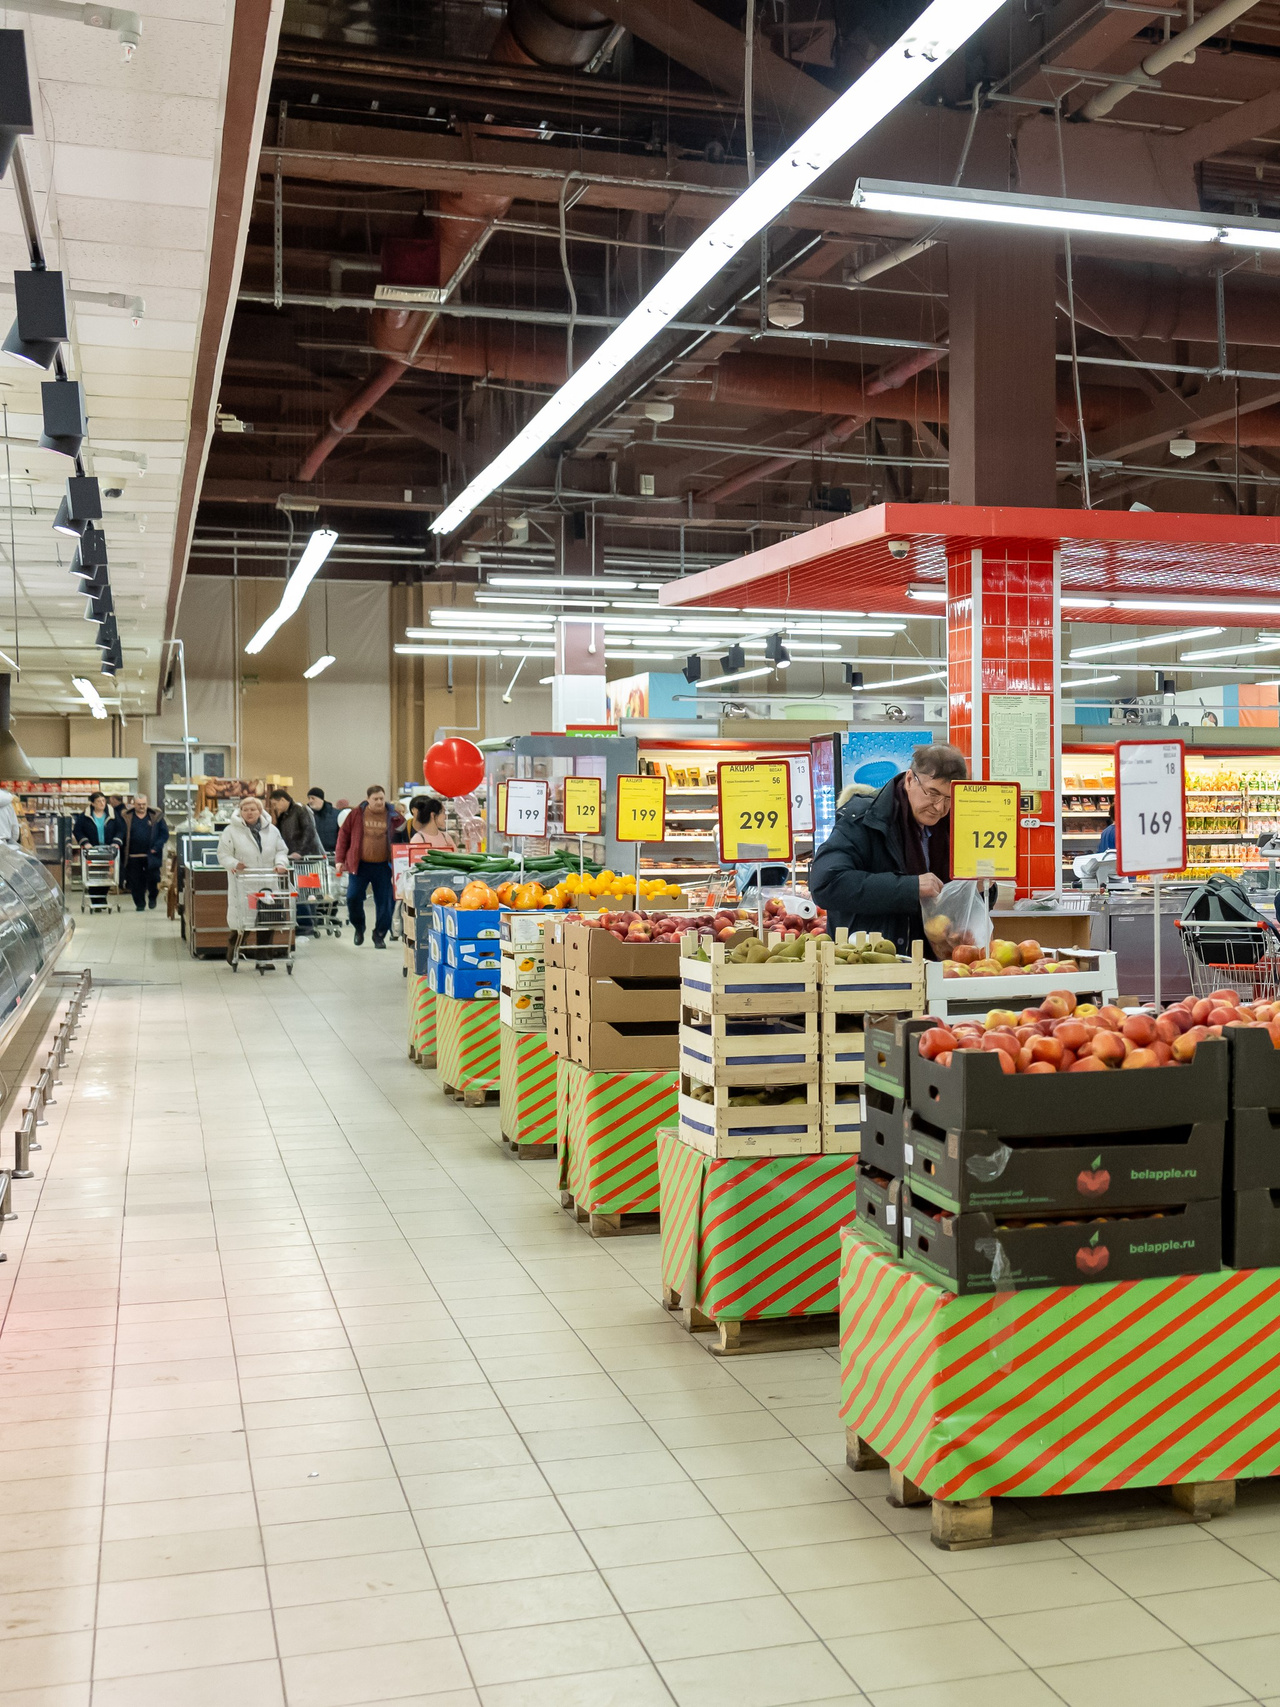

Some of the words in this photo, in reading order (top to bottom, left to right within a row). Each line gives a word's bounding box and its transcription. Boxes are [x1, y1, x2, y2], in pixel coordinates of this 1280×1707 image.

[729, 764, 755, 773] АКЦИЯ
[797, 766, 806, 774] 13
[1165, 762, 1176, 775] 18
[772, 776, 781, 784] 56
[963, 785, 987, 793] АКЦИЯ
[1003, 798, 1011, 806] 19
[518, 809, 540, 820] 199
[576, 805, 596, 816] 129
[631, 809, 657, 821] 199
[739, 810, 779, 830] 299
[1138, 811, 1172, 835] 169
[972, 830, 1008, 849] 129
[1130, 1169, 1197, 1180] belapple.ru
[1129, 1239, 1196, 1254] belapple.ru
